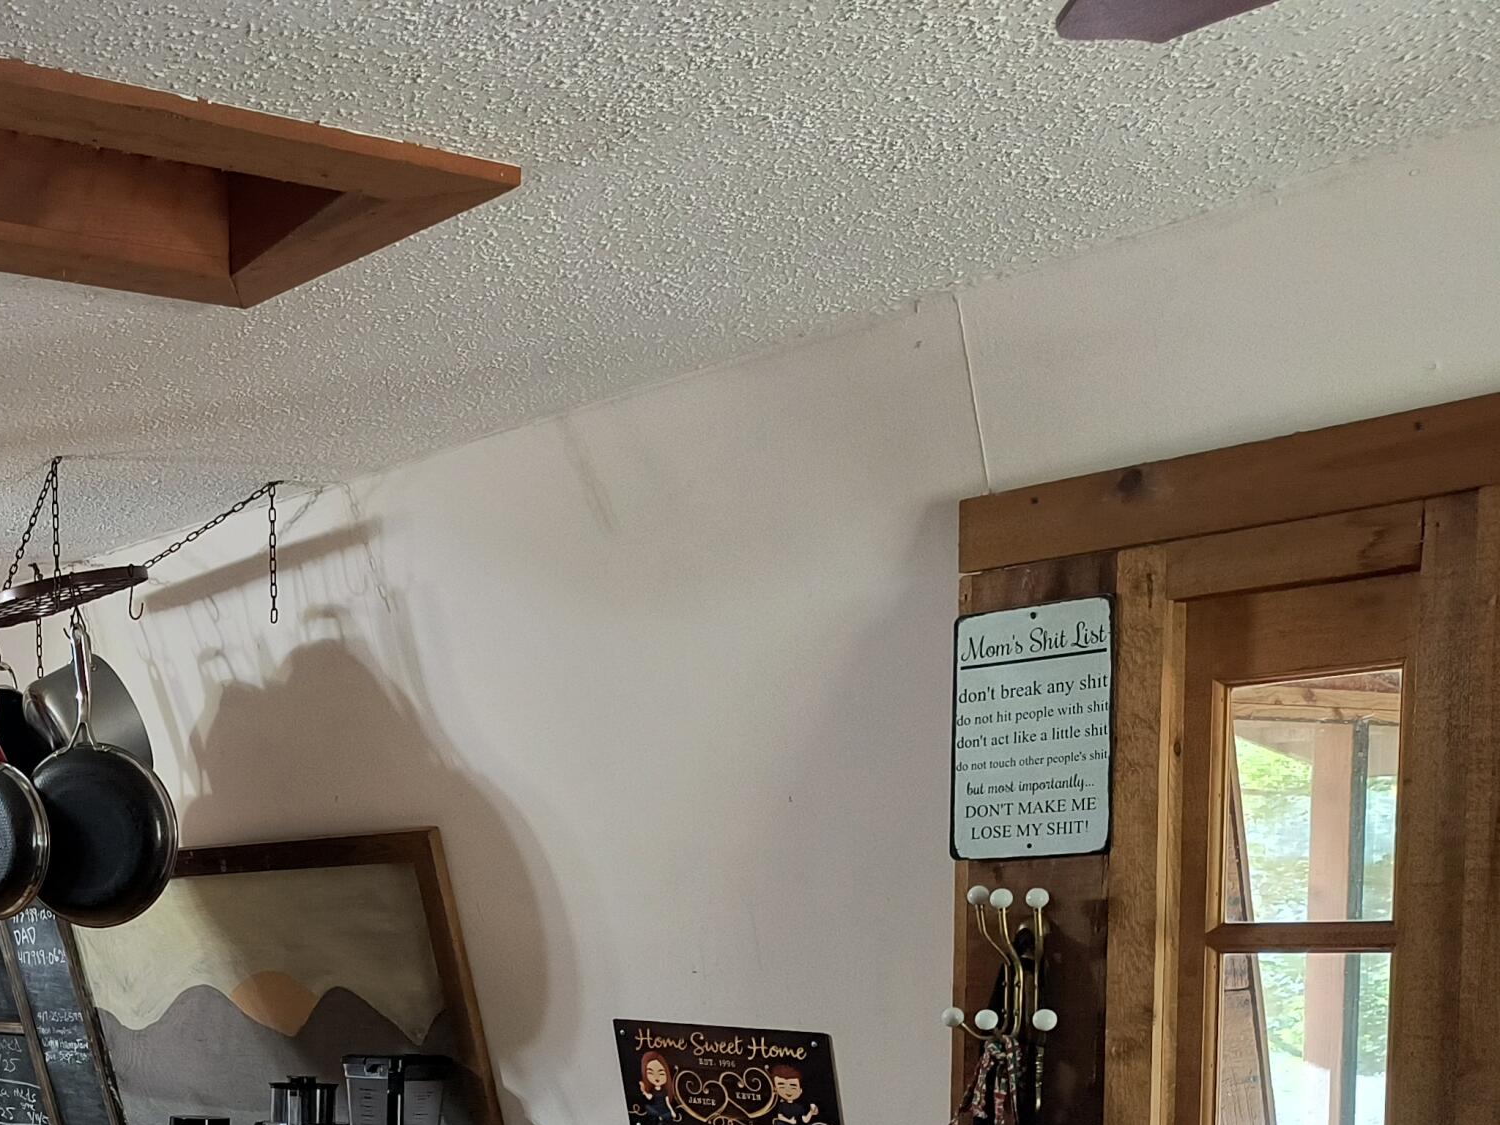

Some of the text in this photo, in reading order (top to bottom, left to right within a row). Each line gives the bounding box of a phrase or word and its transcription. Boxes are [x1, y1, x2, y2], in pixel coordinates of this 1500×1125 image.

[961, 621, 1107, 662] Mom's Shit List
[959, 673, 1109, 704] don't break any shit
[956, 700, 1109, 727] do not hit people with shit
[956, 723, 1109, 749] don't act like a little shit
[956, 749, 1108, 772] do not touch other people's shit
[966, 782, 985, 795] but
[988, 781, 1015, 794] most
[965, 796, 1097, 819] DON'T MAKE ME
[971, 820, 1089, 840] LOSE MY SHIT!
[13, 926, 36, 946] DAD
[635, 1027, 807, 1060] Home Sweet Home
[688, 1096, 716, 1107] JANICE
[735, 1091, 762, 1101] KEVIN
